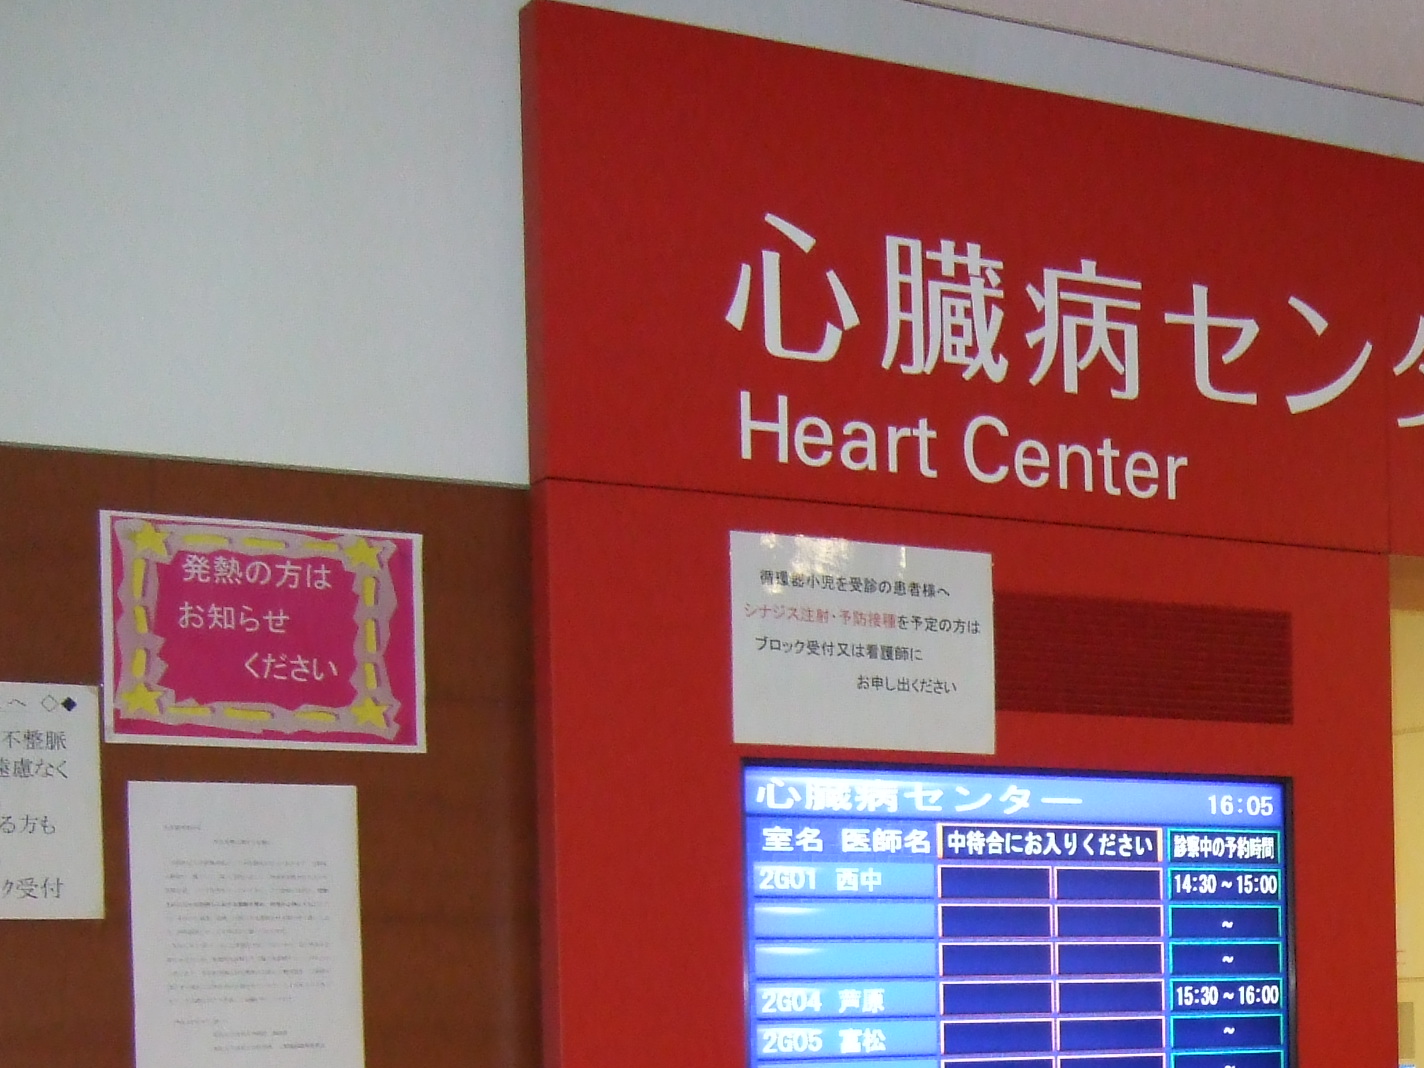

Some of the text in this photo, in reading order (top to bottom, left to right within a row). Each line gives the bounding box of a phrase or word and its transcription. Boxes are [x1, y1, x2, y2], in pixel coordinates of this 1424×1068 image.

[738, 390, 1189, 501] Heart Center
[182, 554, 333, 591] 発熱の方は
[177, 600, 290, 634] お知らせ
[755, 636, 923, 662] ブロック受付又は看護師に
[244, 652, 338, 683] ください
[856, 674, 957, 695] お申し出ください
[756, 776, 1274, 817] 心臓病センター 16:05
[762, 826, 931, 854] 室名 医師名
[947, 828, 1154, 858] 中待合にお入りください
[1174, 834, 1275, 859] 診察中の予約時間
[759, 866, 816, 890] 2G01
[835, 866, 883, 892] 西中
[762, 988, 822, 1013] 2G04
[762, 1028, 823, 1054] 2G05
